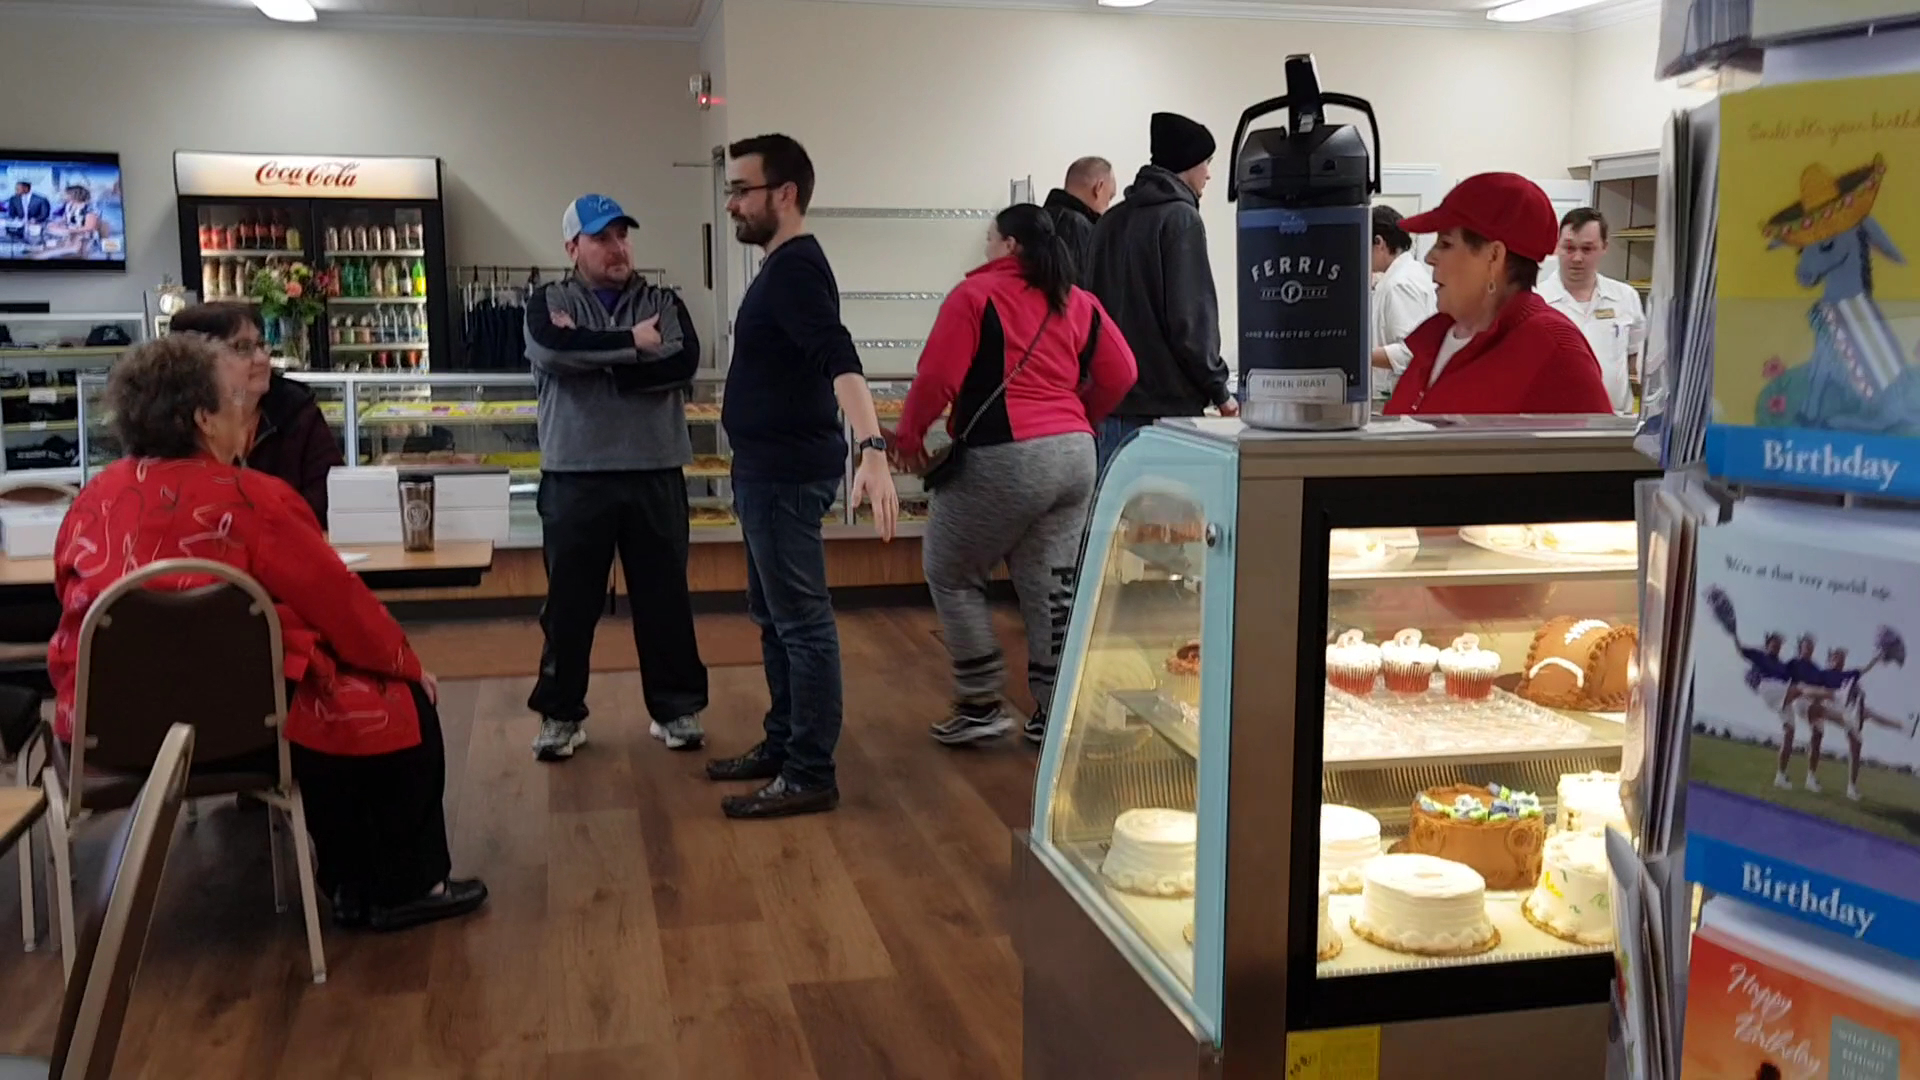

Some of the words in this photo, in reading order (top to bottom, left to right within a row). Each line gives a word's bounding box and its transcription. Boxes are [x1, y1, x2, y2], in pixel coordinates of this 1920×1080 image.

[255, 159, 360, 187] Coca-Cola
[1251, 256, 1340, 283] FERRIS
[1313, 328, 1348, 337] COFFEE
[1296, 378, 1326, 387] ROAST
[1764, 440, 1900, 491] Birthday
[1799, 574, 1823, 591] very
[1741, 861, 1876, 938] Birthday
[1727, 962, 1793, 1023] Happy
[1734, 1012, 1821, 1076] Birthday
